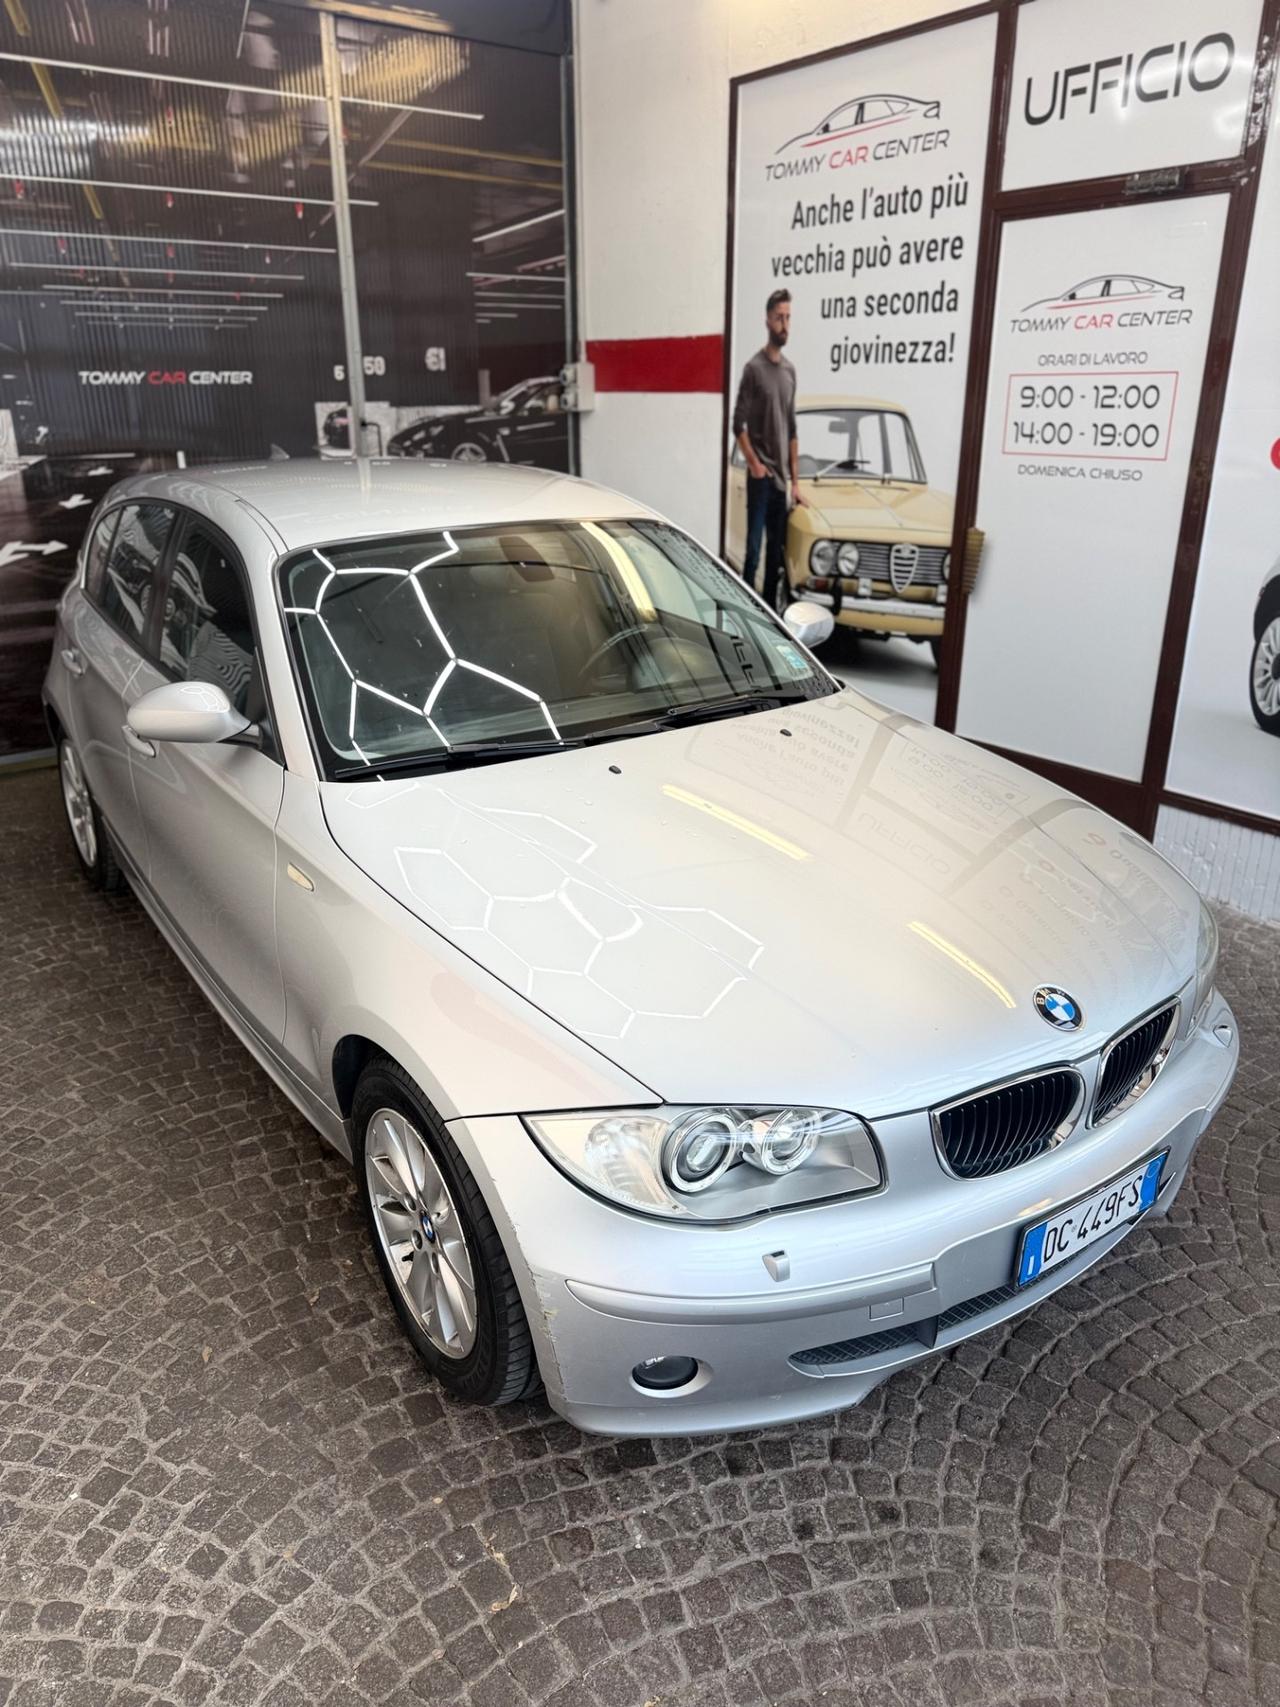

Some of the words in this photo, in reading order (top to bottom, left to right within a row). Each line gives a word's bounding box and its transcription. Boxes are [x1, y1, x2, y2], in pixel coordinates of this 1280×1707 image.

[1024, 32, 1235, 126] UFFICIO
[766, 155, 826, 181] TOMMY
[829, 145, 869, 170] CAR
[873, 129, 950, 161] CENTER
[792, 193, 854, 229] Anche
[861, 185, 923, 220] l'auto
[931, 172, 968, 219] più
[771, 243, 845, 278] vecchia
[852, 235, 892, 278] può
[899, 236, 964, 266] avere
[820, 296, 857, 320] una
[864, 281, 959, 317] seconda
[1011, 316, 1071, 333] TOMMY
[1074, 313, 1114, 330] CAR
[1117, 309, 1193, 328] CENTER
[830, 333, 956, 373] giovinezza!
[1037, 353, 1077, 367] ORARI
[1079, 352, 1091, 367] DI
[1093, 351, 1149, 367] LAVORO
[79, 371, 145, 385] TOMMY
[148, 371, 186, 385] CAR
[189, 371, 253, 385] CENTER
[1020, 385, 1074, 409] 9:00
[1093, 384, 1160, 410] 12:00
[1013, 421, 1073, 445] 14:00
[1092, 423, 1160, 448] 19:00
[1017, 463, 1086, 479] DOMENICA
[1089, 467, 1143, 482] CHIUSO
